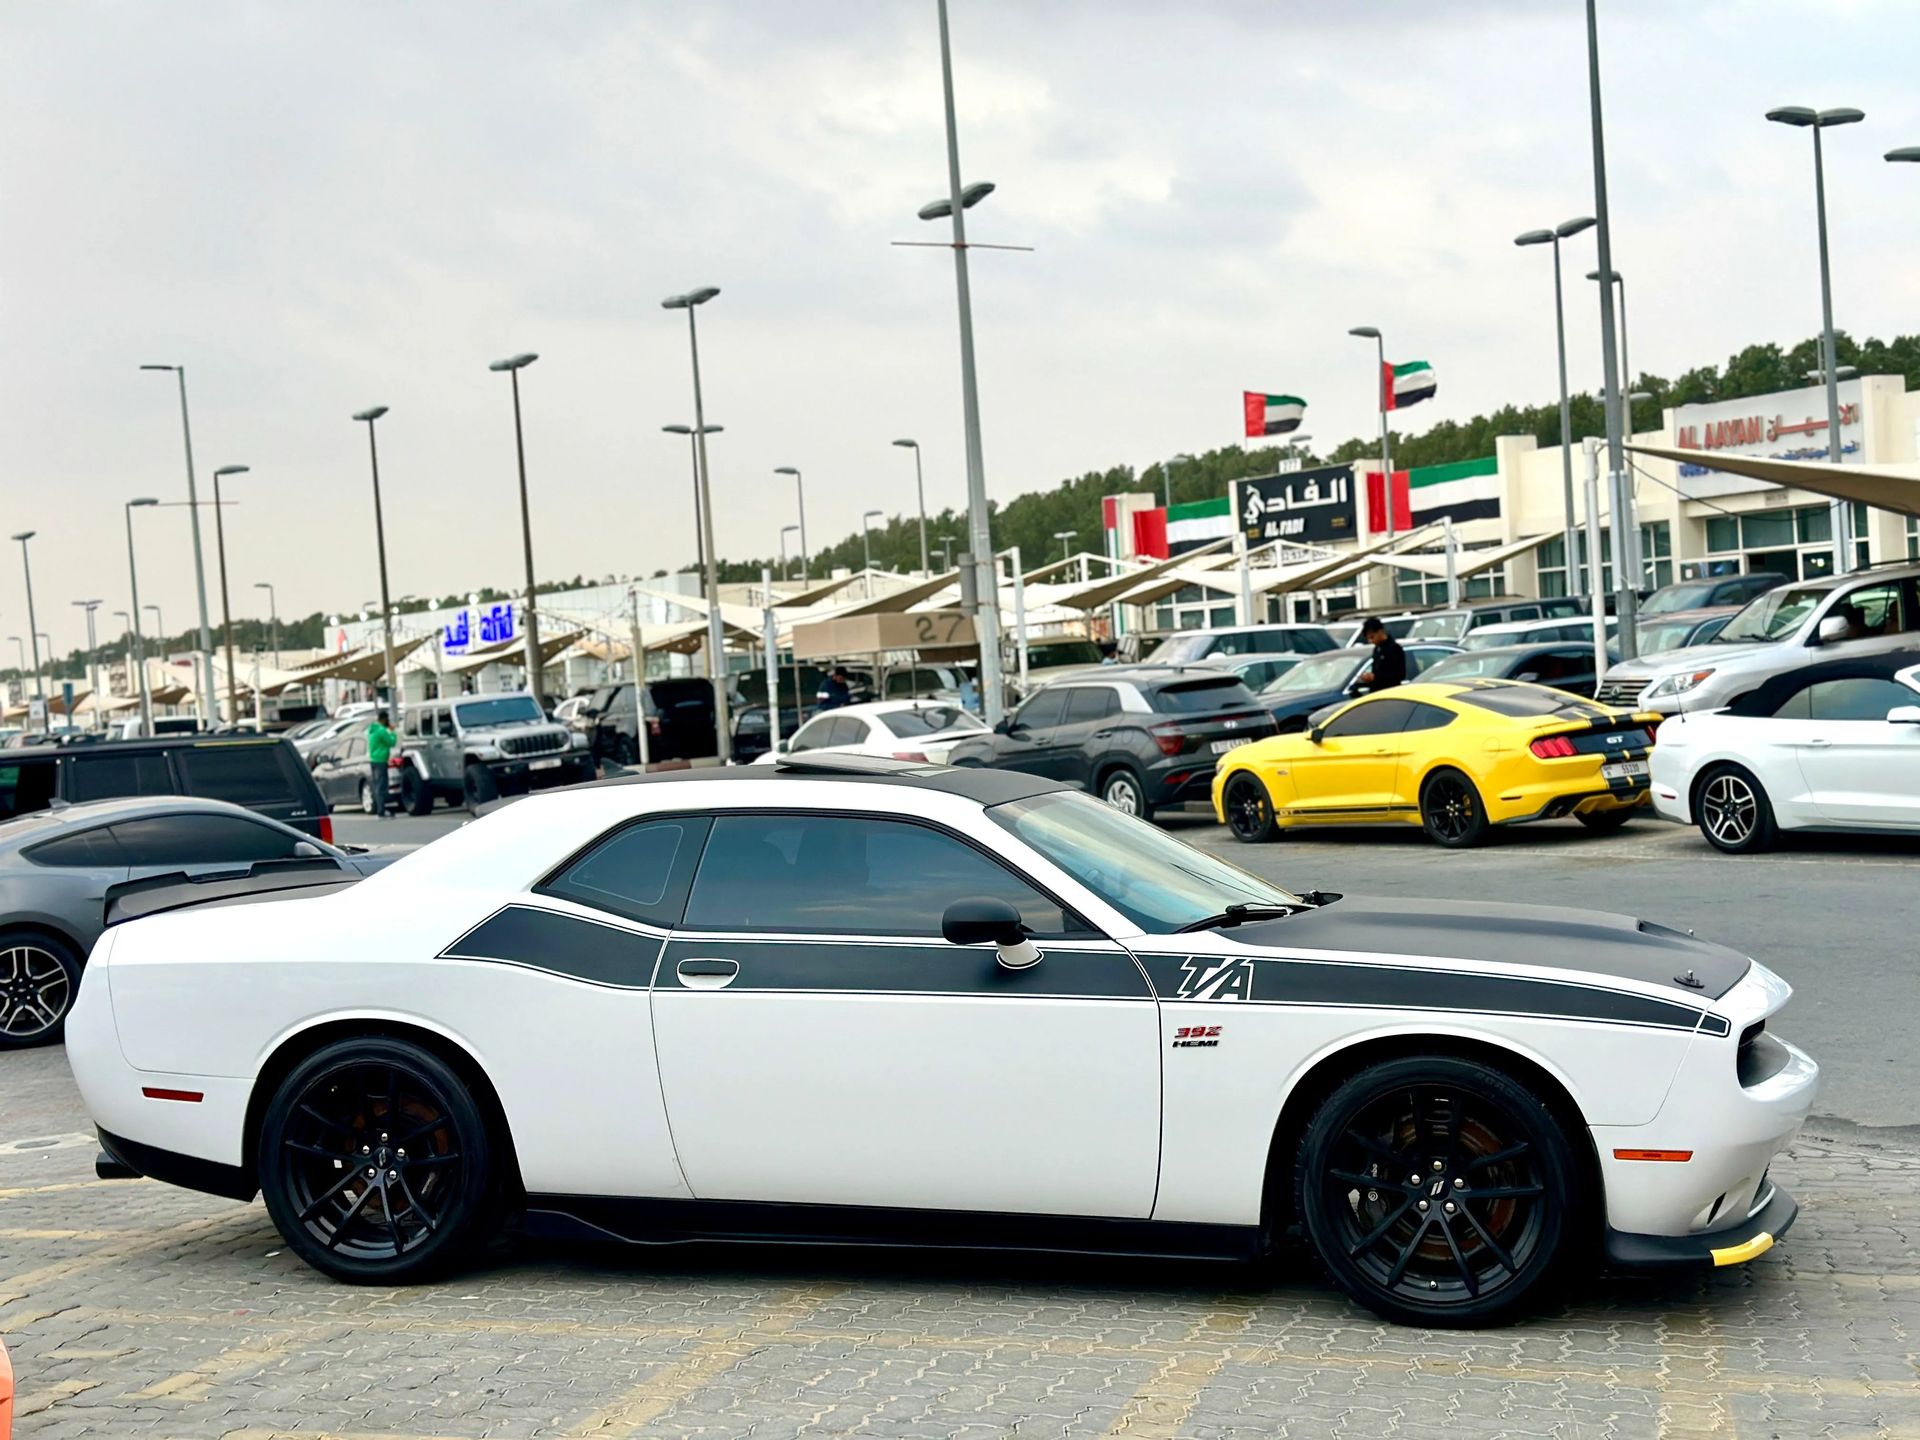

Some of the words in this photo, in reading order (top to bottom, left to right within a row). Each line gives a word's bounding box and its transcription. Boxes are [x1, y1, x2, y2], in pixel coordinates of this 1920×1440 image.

[1678, 426, 1702, 449] AL
[1704, 416, 1764, 450] AAYAN
[1264, 521, 1279, 538] AL
[915, 612, 964, 643] 27
[1606, 735, 1623, 744] GT
[1174, 1026, 1222, 1039] 392
[1172, 1040, 1219, 1048] HEMI
